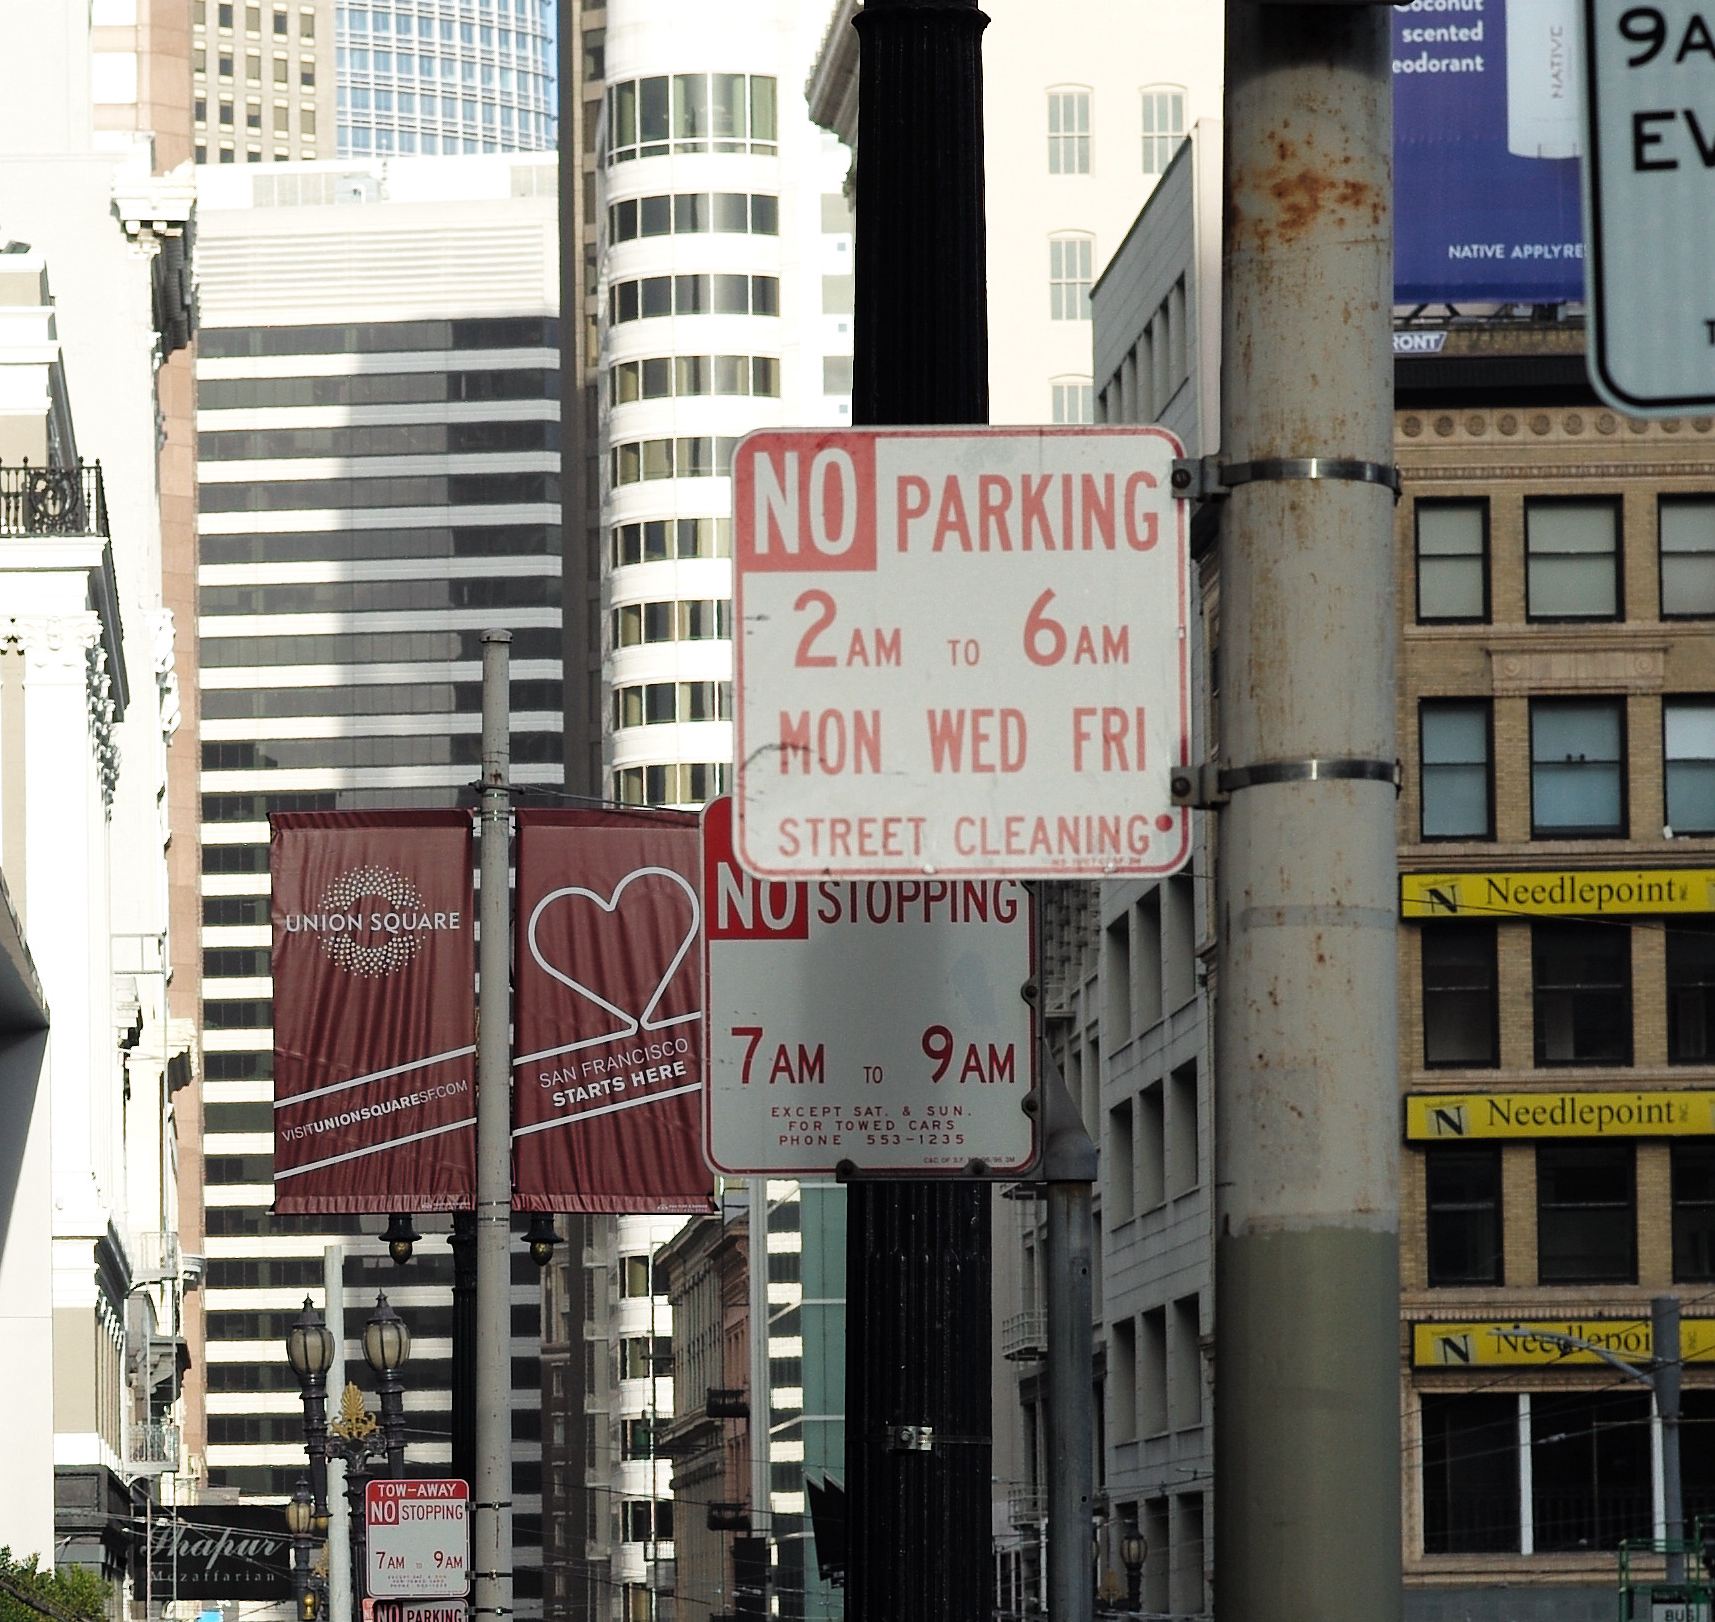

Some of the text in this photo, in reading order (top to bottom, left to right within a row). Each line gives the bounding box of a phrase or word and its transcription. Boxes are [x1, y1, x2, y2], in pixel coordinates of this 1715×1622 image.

[1401, 23, 1484, 44] scented
[1392, 52, 1485, 74] eodorant
[1448, 242, 1588, 261] NATIVE APPLYRE
[1393, 334, 1441, 352] RONT
[753, 446, 1160, 558] NO PARKING
[793, 587, 1131, 670] 2AM TO 6AM
[778, 705, 1147, 777] MON WED FRI
[777, 813, 1151, 858] STREET CLEANING
[717, 861, 1019, 931] NO STOPPING
[1486, 874, 1677, 911] Needlepoint
[284, 910, 461, 936] UNION SQUARE
[538, 1037, 690, 1090] SAN FRANCISCO
[730, 1024, 1017, 1085] 7AM TO 9AM
[551, 1060, 687, 1108] STARTS HERE
[281, 1078, 469, 1143] VISITUNIONSQUARESF.COM
[771, 1104, 973, 1118] EXCEPT SAT. & SUN.
[1487, 1095, 1675, 1133] Needlepoint
[788, 1119, 956, 1132] FOR TOWED CARS
[778, 1133, 966, 1146] PHONE 553-1235
[378, 1483, 457, 1498] TOW-AWAY
[371, 1500, 464, 1523] NO STOPPING
[375, 1551, 405, 1570] 7AM
[433, 1550, 463, 1569] 9AM
[1664, 1609, 1695, 1622] BUS
